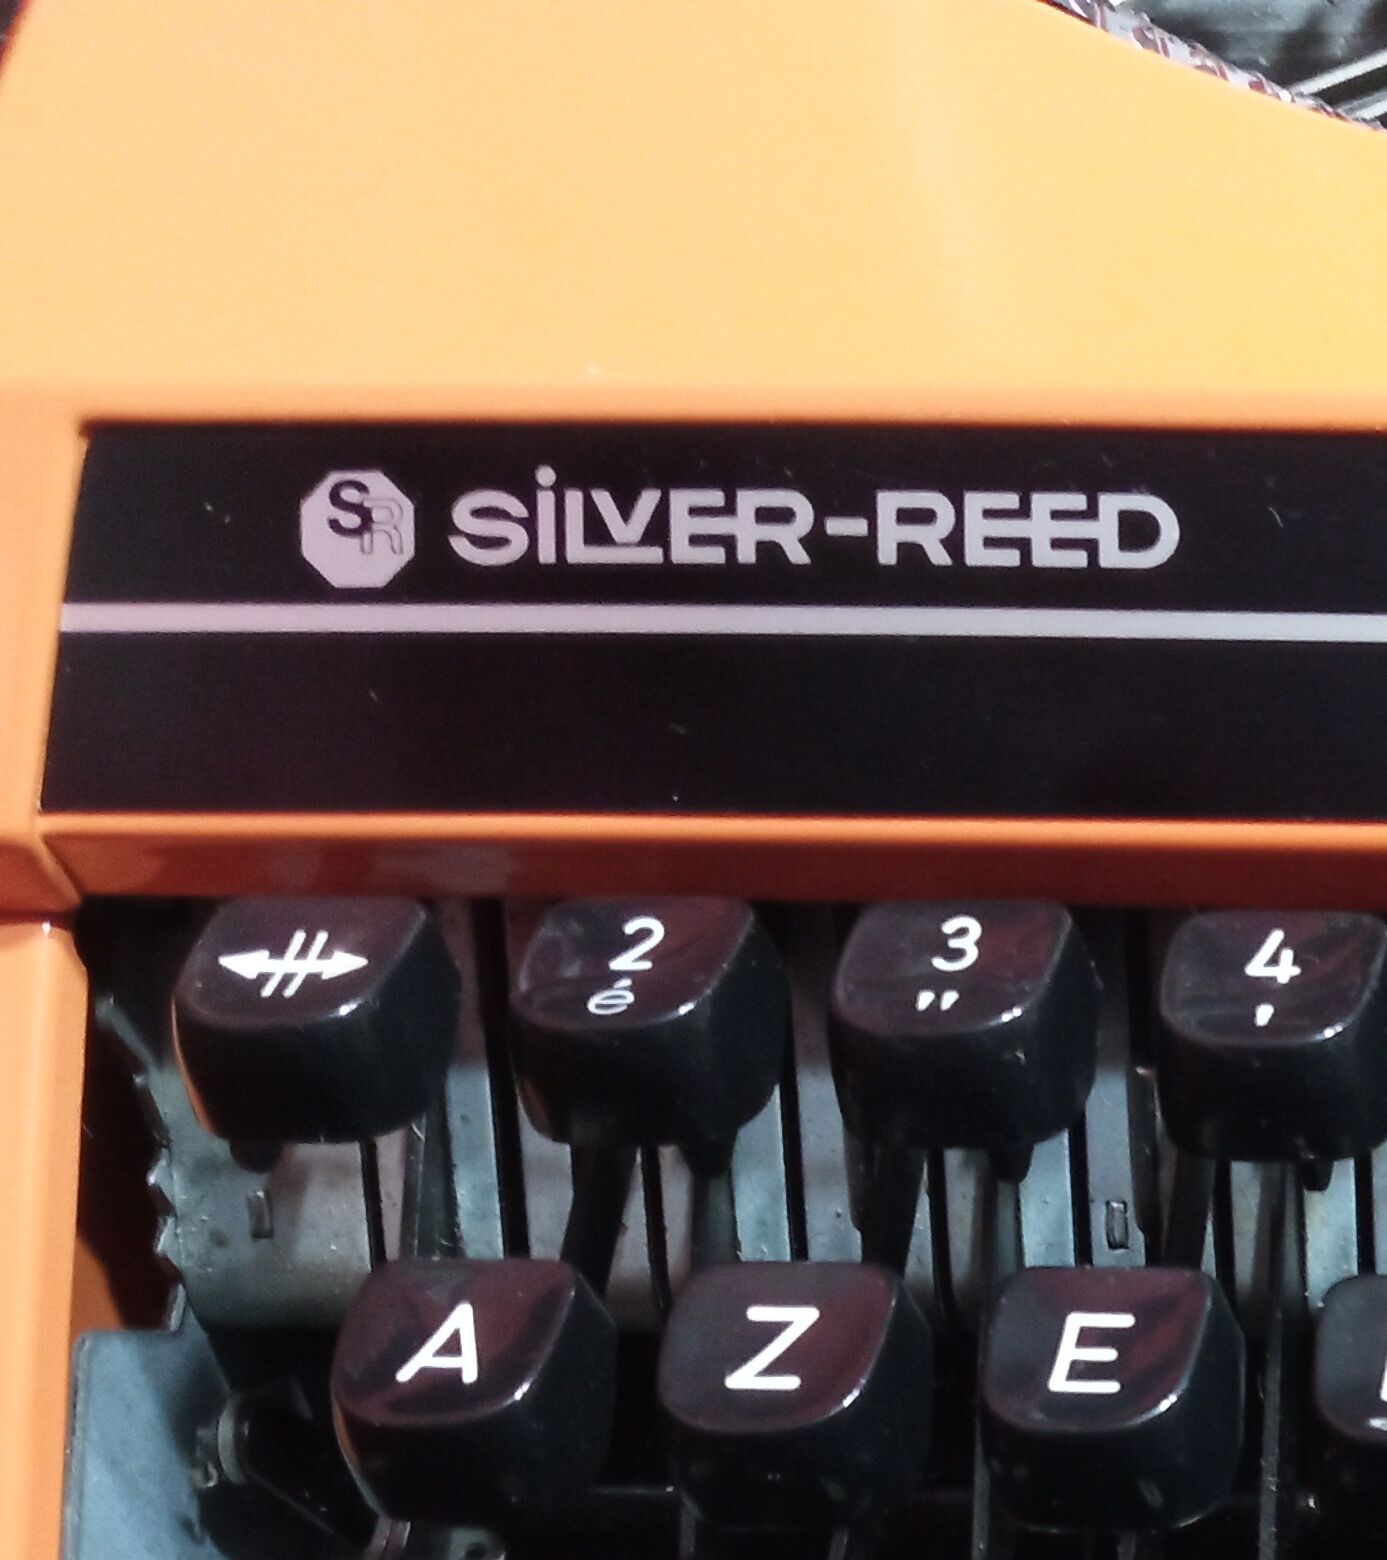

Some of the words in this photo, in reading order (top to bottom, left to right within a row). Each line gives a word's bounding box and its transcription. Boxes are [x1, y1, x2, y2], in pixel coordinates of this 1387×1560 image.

[607, 915, 666, 972] 2
[930, 915, 983, 973] 3
[1243, 928, 1303, 986] 4
[586, 976, 636, 1016] é
[394, 1301, 480, 1385] A
[723, 1304, 821, 1392] Z
[1046, 1310, 1137, 1395] E
